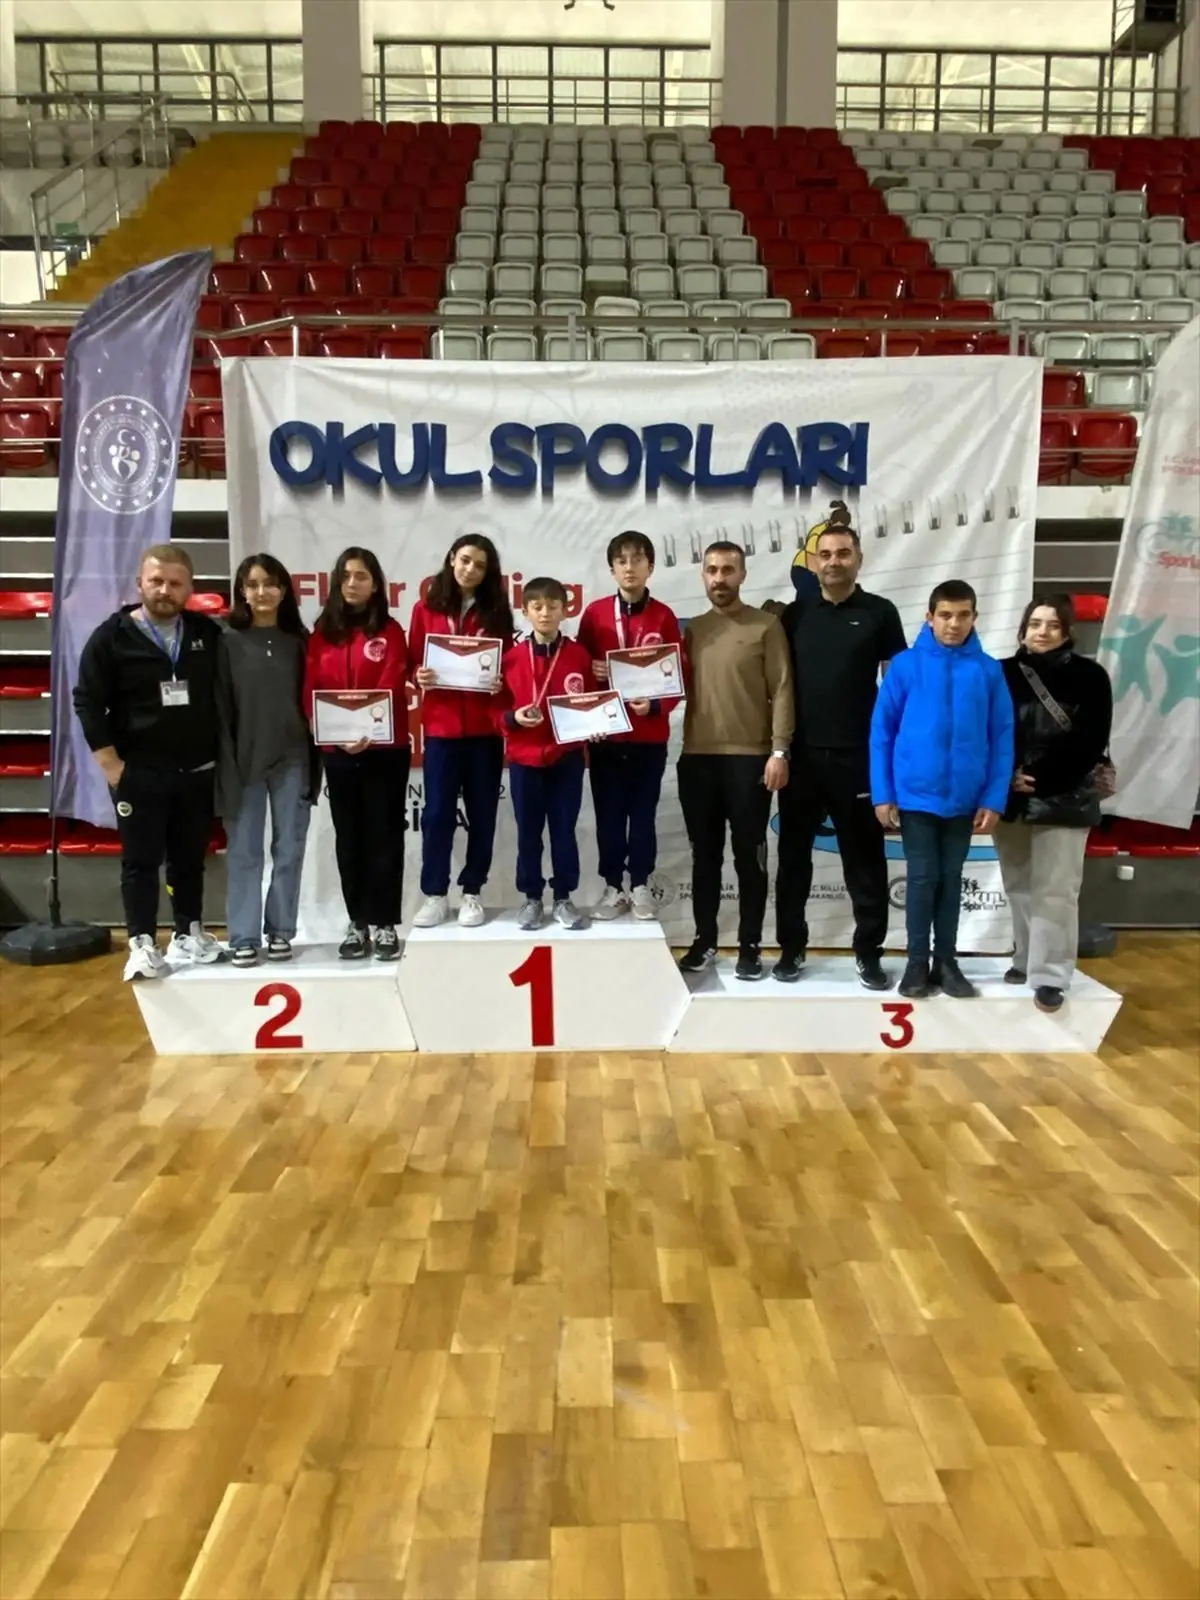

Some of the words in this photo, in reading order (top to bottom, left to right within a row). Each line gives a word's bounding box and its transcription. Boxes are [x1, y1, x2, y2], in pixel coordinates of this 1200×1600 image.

[270, 420, 483, 488] OKUL
[488, 421, 870, 490] SPORLARI
[291, 572, 406, 608] Flr
[254, 982, 303, 1048] 2
[509, 946, 554, 1046] 1
[880, 1003, 914, 1049] 3
